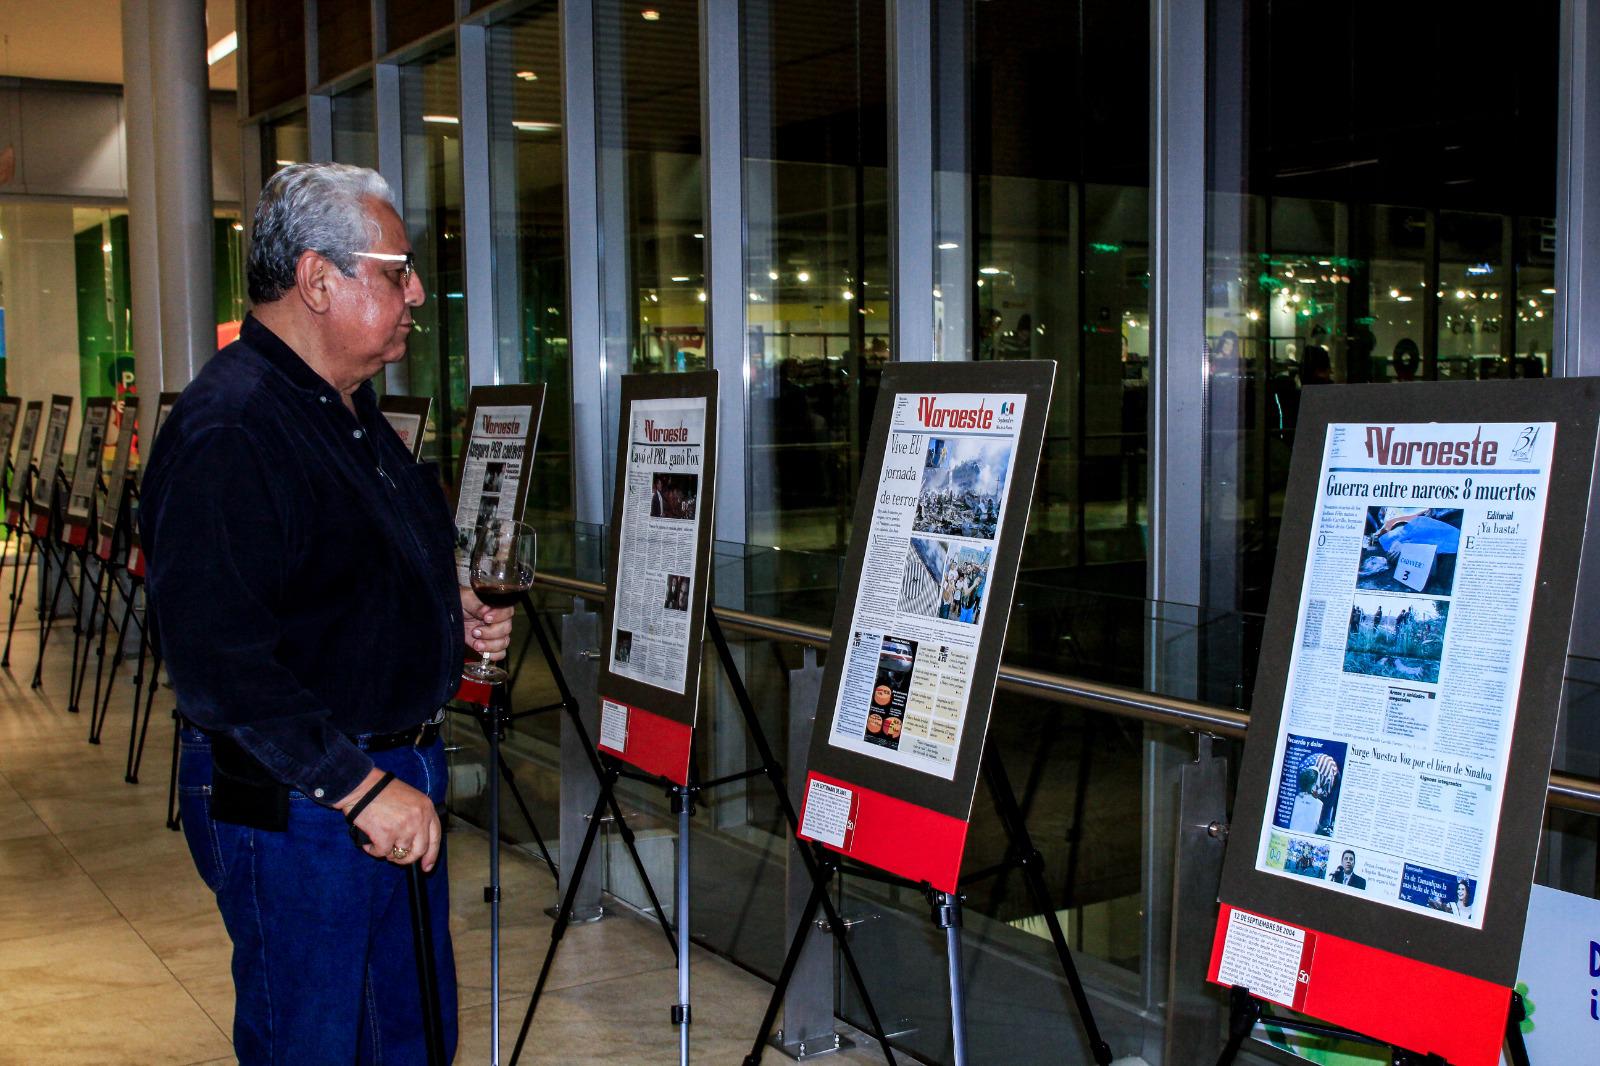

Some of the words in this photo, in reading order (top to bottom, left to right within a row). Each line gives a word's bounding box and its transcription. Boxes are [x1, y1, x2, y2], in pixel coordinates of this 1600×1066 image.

[918, 396, 993, 430] Noroeste
[645, 418, 688, 442] Noroeste
[891, 434, 908, 454] Vive
[909, 434, 923, 455] EU
[1364, 425, 1499, 466] Noroeste
[647, 448, 653, 464] el
[686, 448, 699, 466] Fox
[883, 466, 917, 483] jornada
[880, 490, 891, 505] de
[892, 496, 917, 507] terror
[1326, 475, 1369, 497] Guerra
[1373, 481, 1408, 498] entre
[1411, 482, 1459, 500] narcos:
[1463, 478, 1472, 500] 8
[1475, 482, 1536, 501] muertos
[1486, 510, 1514, 521] Editorial
[1477, 522, 1491, 536] ¡Ya
[1493, 522, 1520, 535] basta!
[1402, 570, 1411, 581] 3
[1351, 744, 1370, 760] Surge
[1372, 747, 1398, 763] Nuestra
[1400, 753, 1411, 765] Voz
[1412, 758, 1425, 770] por
[1426, 758, 1434, 769] el
[1435, 759, 1452, 772] bien
[1453, 762, 1463, 775] de
[1465, 764, 1492, 781] Sinaloa
[1234, 912, 1240, 920] 12
[1241, 914, 1247, 922] DE
[1247, 915, 1276, 930] SEPTIEMBRE
[1276, 924, 1282, 932] DE
[1283, 926, 1295, 937] 2004
